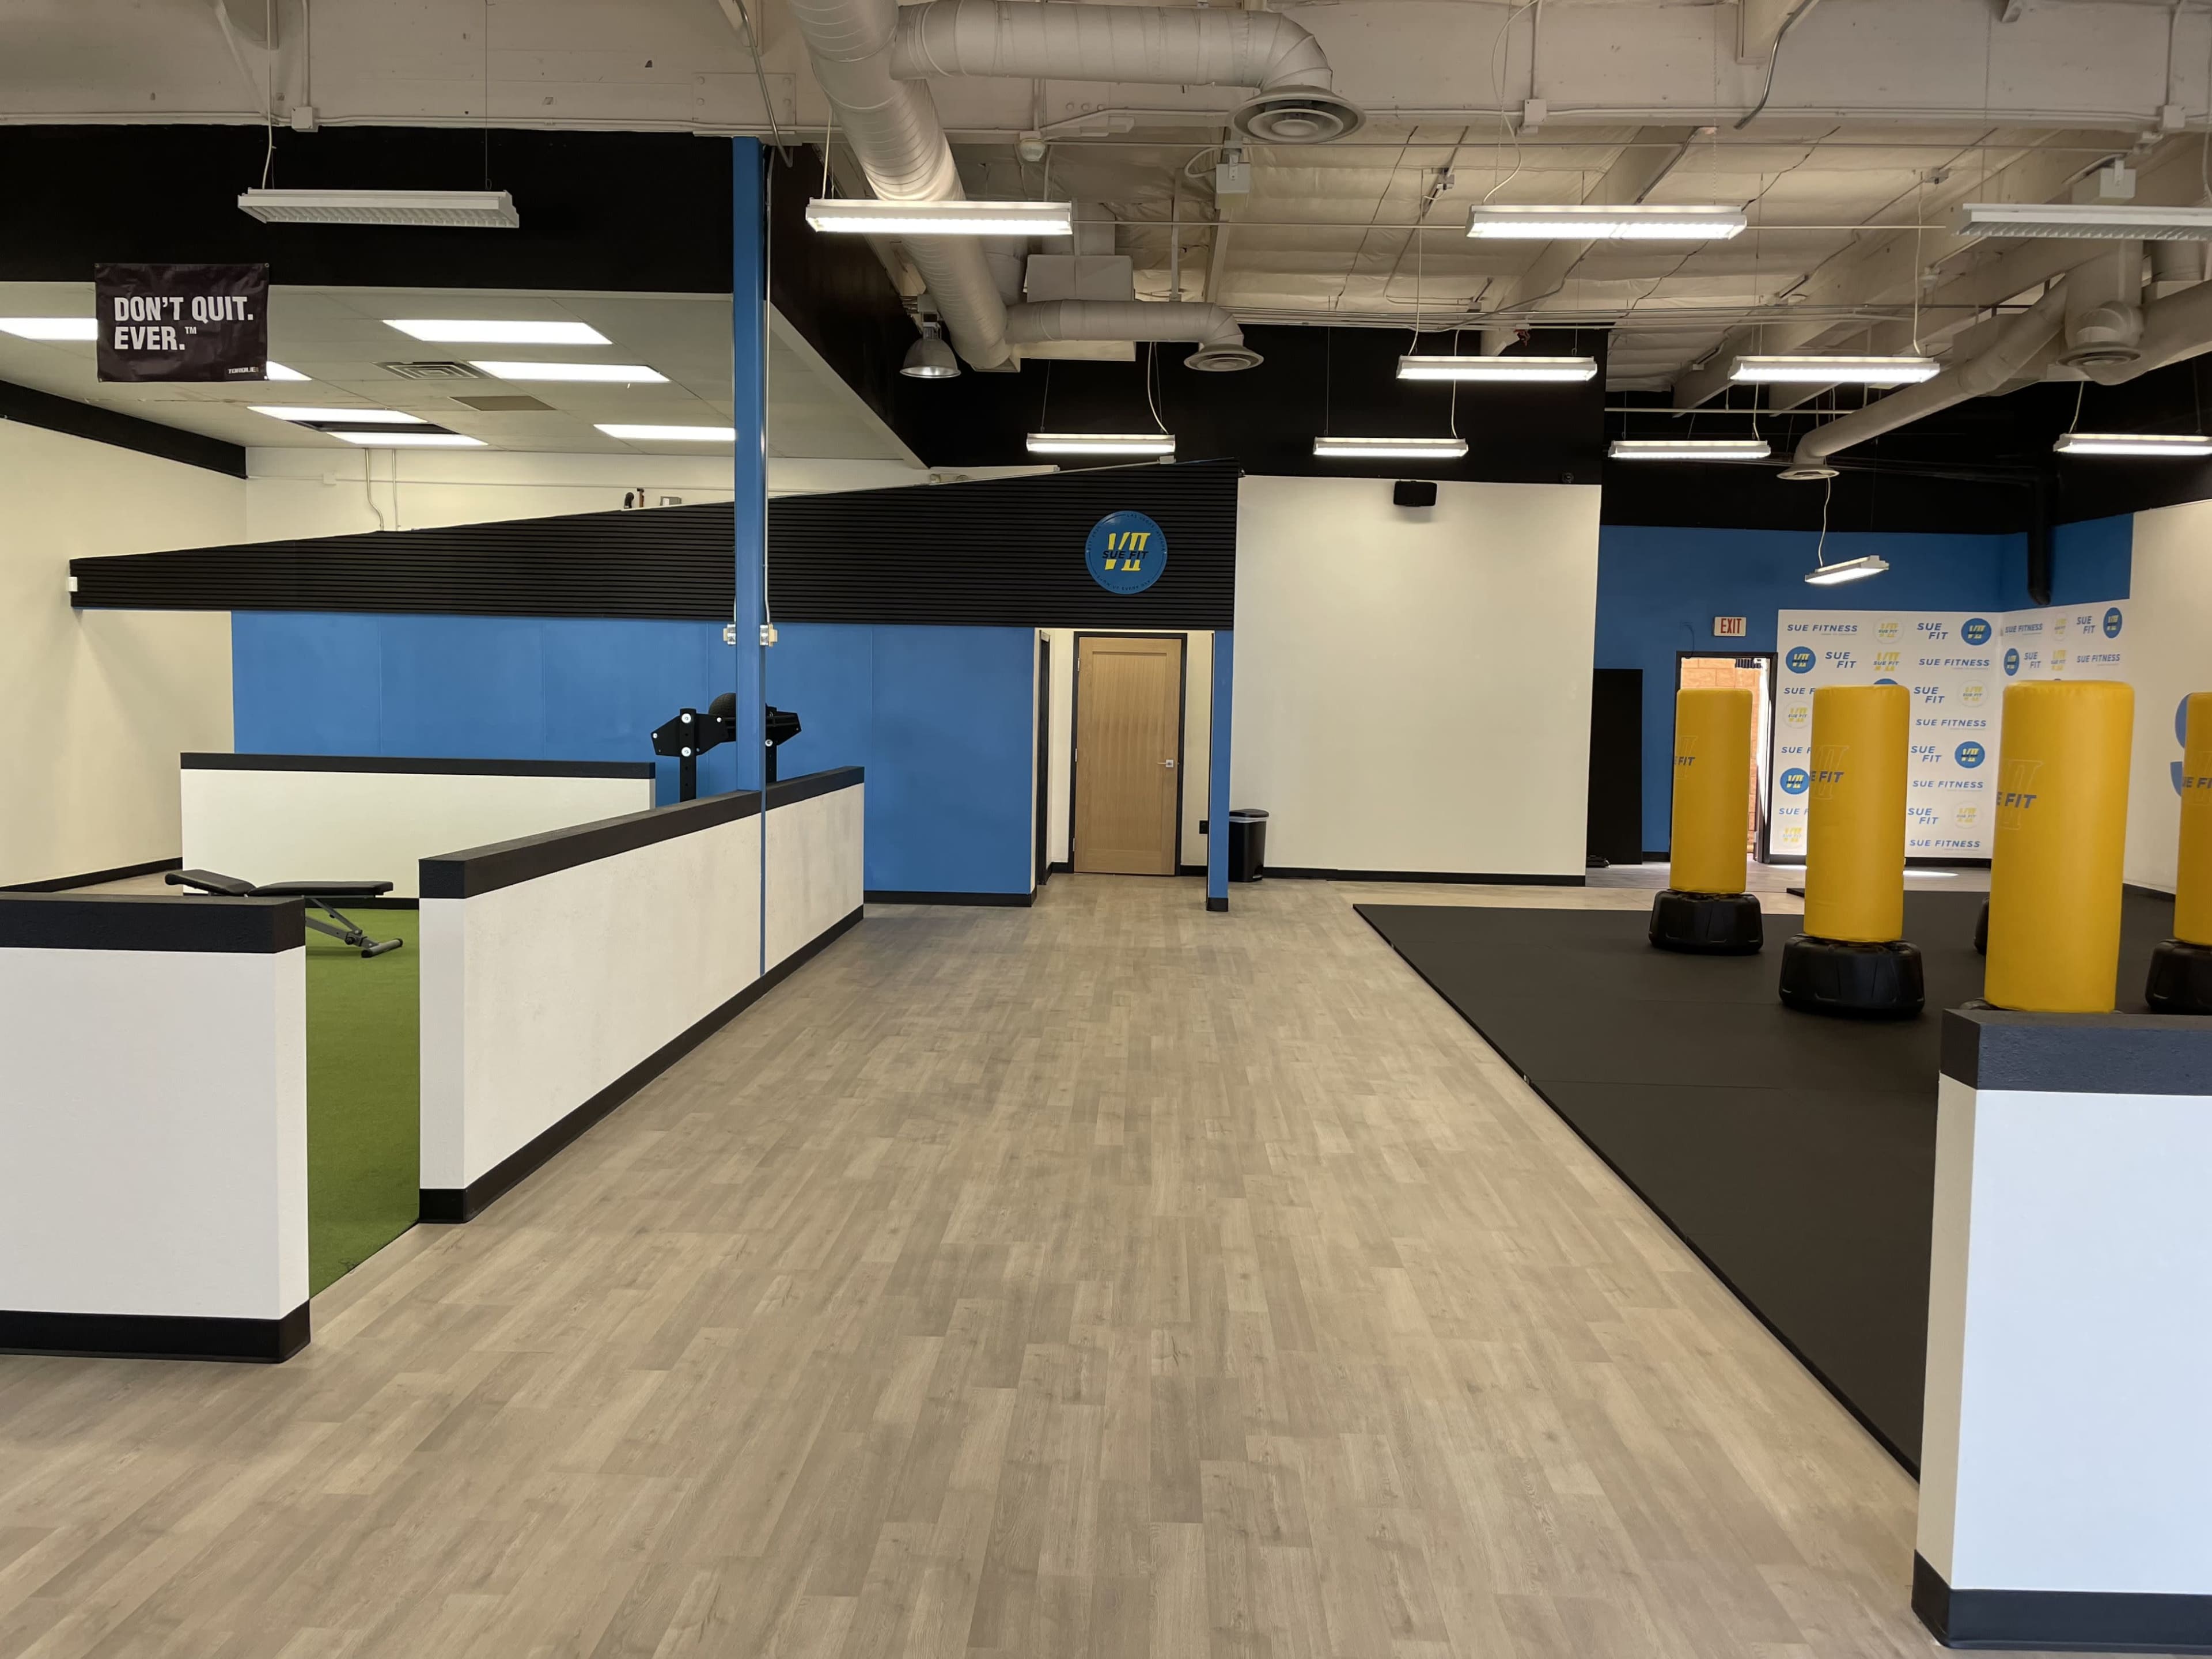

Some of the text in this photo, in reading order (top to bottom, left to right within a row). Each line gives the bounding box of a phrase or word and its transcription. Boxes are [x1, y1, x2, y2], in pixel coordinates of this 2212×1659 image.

[114, 296, 253, 324] DON'T QUIT.
[114, 326, 185, 350] EVER.
[1102, 551, 1149, 559] SUE FIT
[2077, 616, 2092, 625] SUE
[1721, 618, 1742, 634] EXIT
[2018, 623, 2043, 632] FITNESS
[2082, 625, 2095, 634] FIT
[1825, 652, 1850, 660] SUE
[2024, 652, 2038, 660] SUE
[2092, 654, 2120, 662] FITNESS
[1944, 658, 1990, 666] FITNESS
[2030, 661, 2041, 669] FIT
[1925, 695, 1945, 703] FIT
[1910, 745, 1936, 753] SUE
[1678, 756, 1696, 766] FIT
[1922, 755, 1942, 763] FIT
[1819, 771, 1844, 783] FIT
[2004, 792, 2037, 809] FIT
[1908, 808, 1932, 816] SUE
